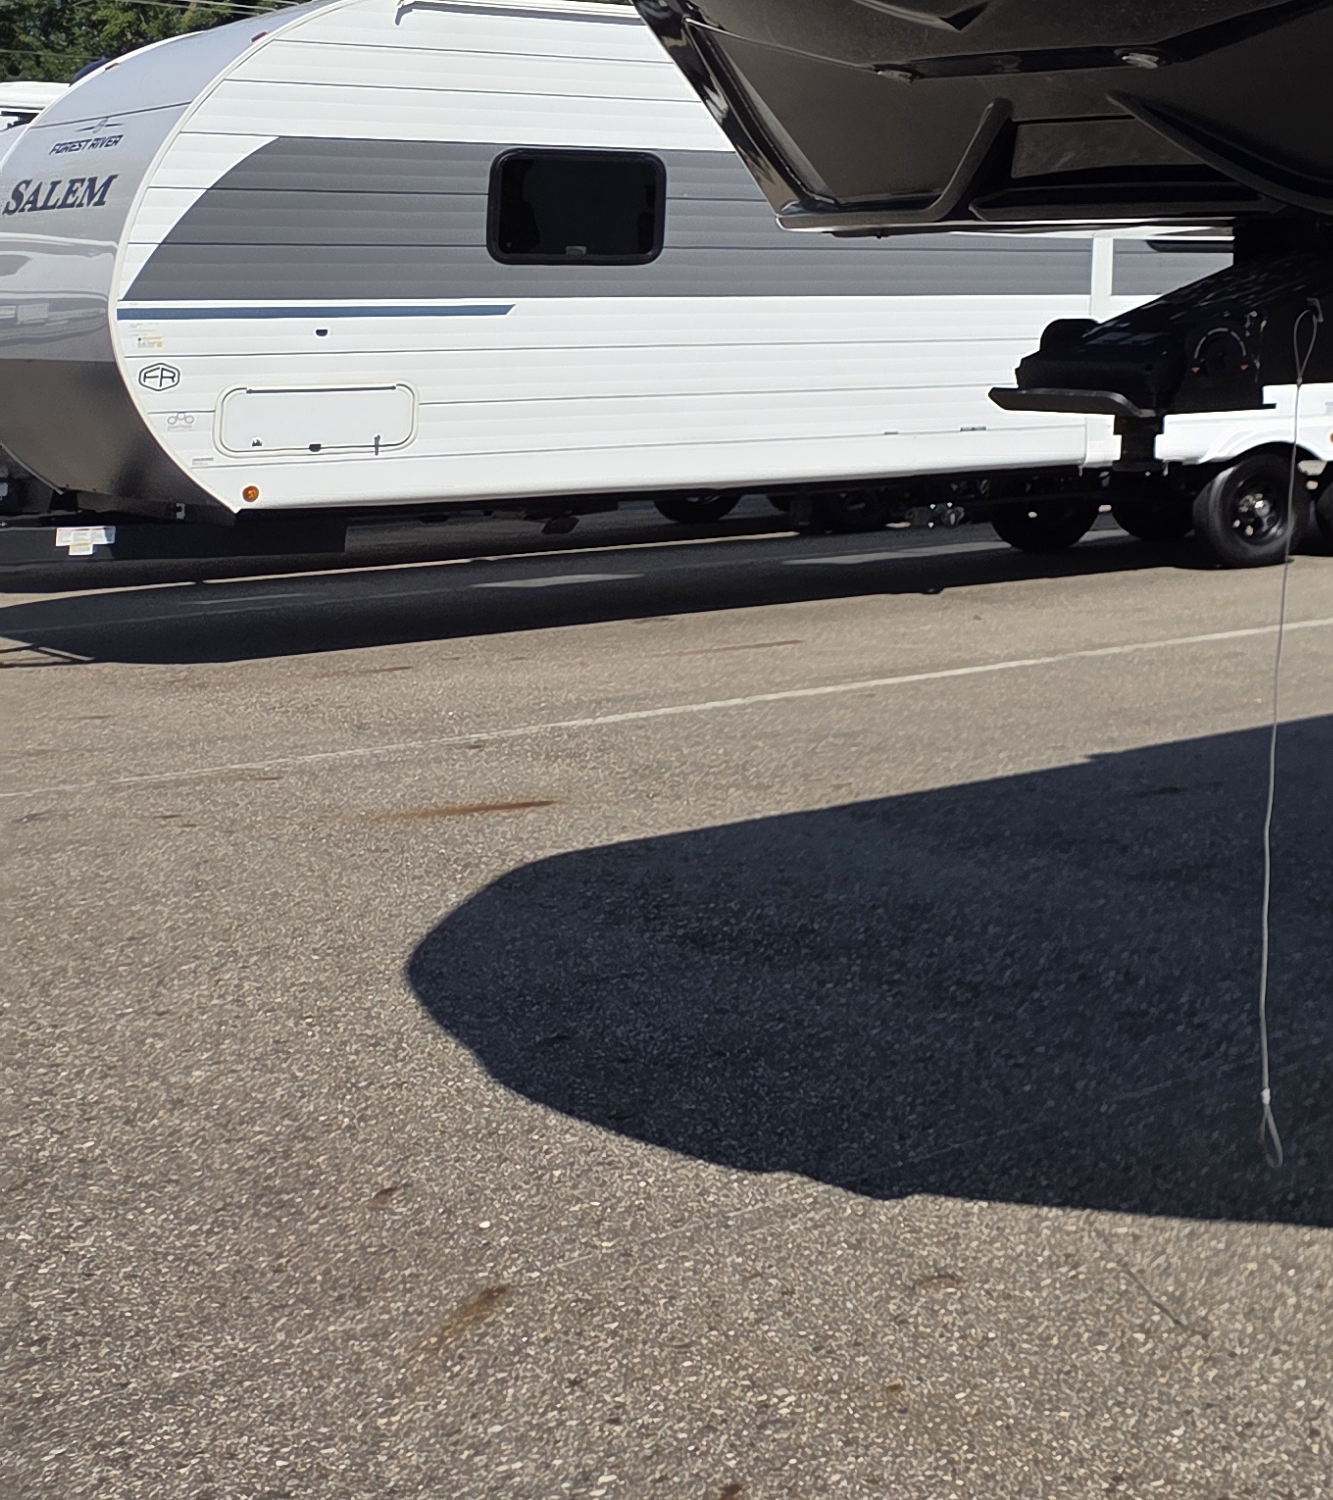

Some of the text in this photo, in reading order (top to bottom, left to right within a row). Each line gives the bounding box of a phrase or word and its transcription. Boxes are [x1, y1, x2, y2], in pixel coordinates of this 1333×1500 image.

[48, 134, 124, 155] FOREST RIVER
[2, 174, 119, 216] SALEM
